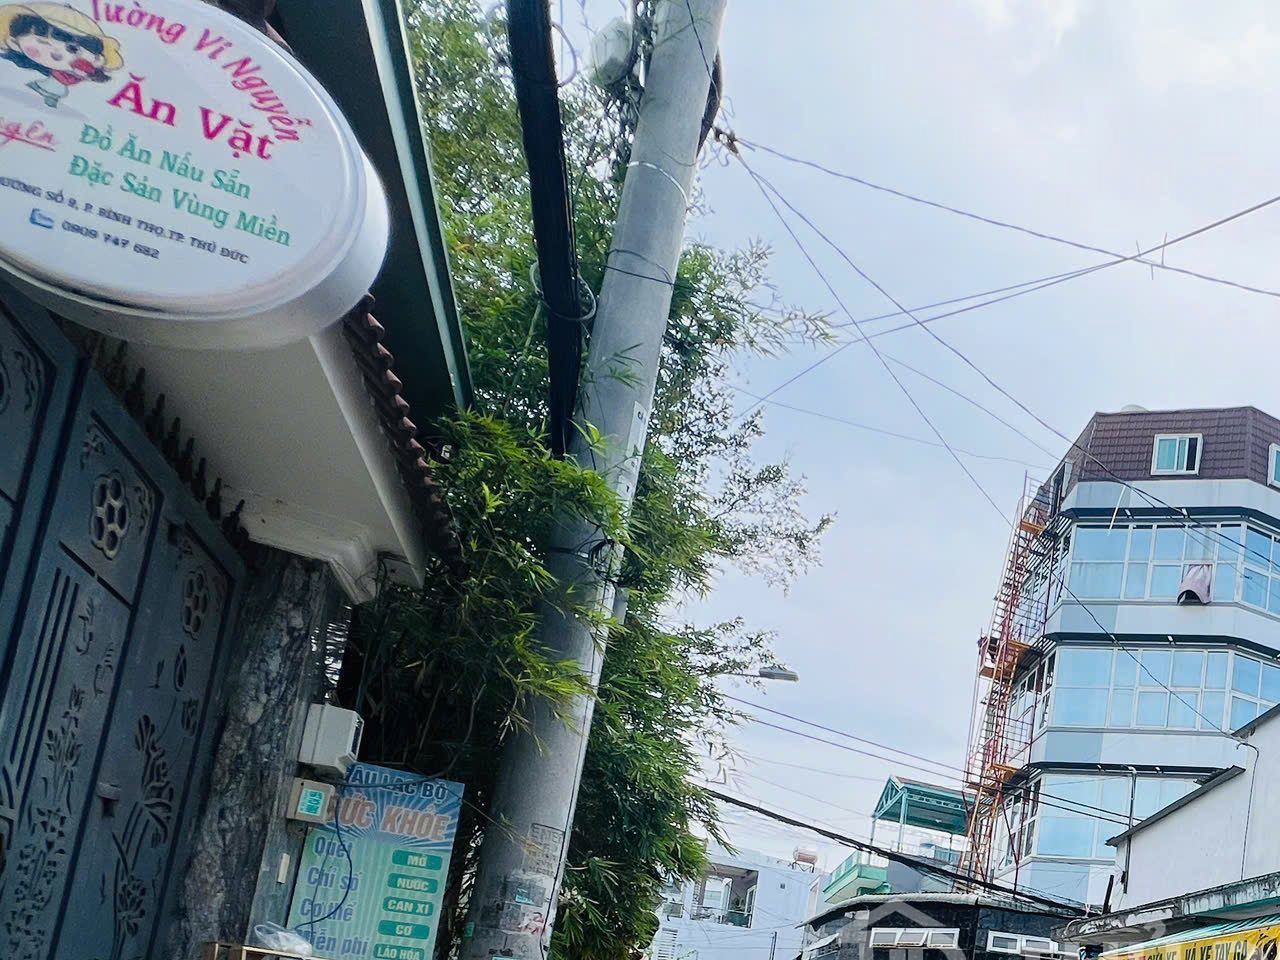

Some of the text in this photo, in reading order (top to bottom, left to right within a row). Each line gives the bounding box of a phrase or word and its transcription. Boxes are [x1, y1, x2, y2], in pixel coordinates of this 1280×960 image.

[106, 72, 274, 160] Ăn Vặt
[222, 57, 313, 142] Nguyễn
[80, 122, 112, 151] Đồ
[117, 132, 152, 165] Ăn
[159, 150, 205, 183] Nấu
[69, 154, 291, 247] Đặc Sản Vùng Miền
[350, 764, 378, 787] ÂU
[387, 900, 414, 912] CAN
